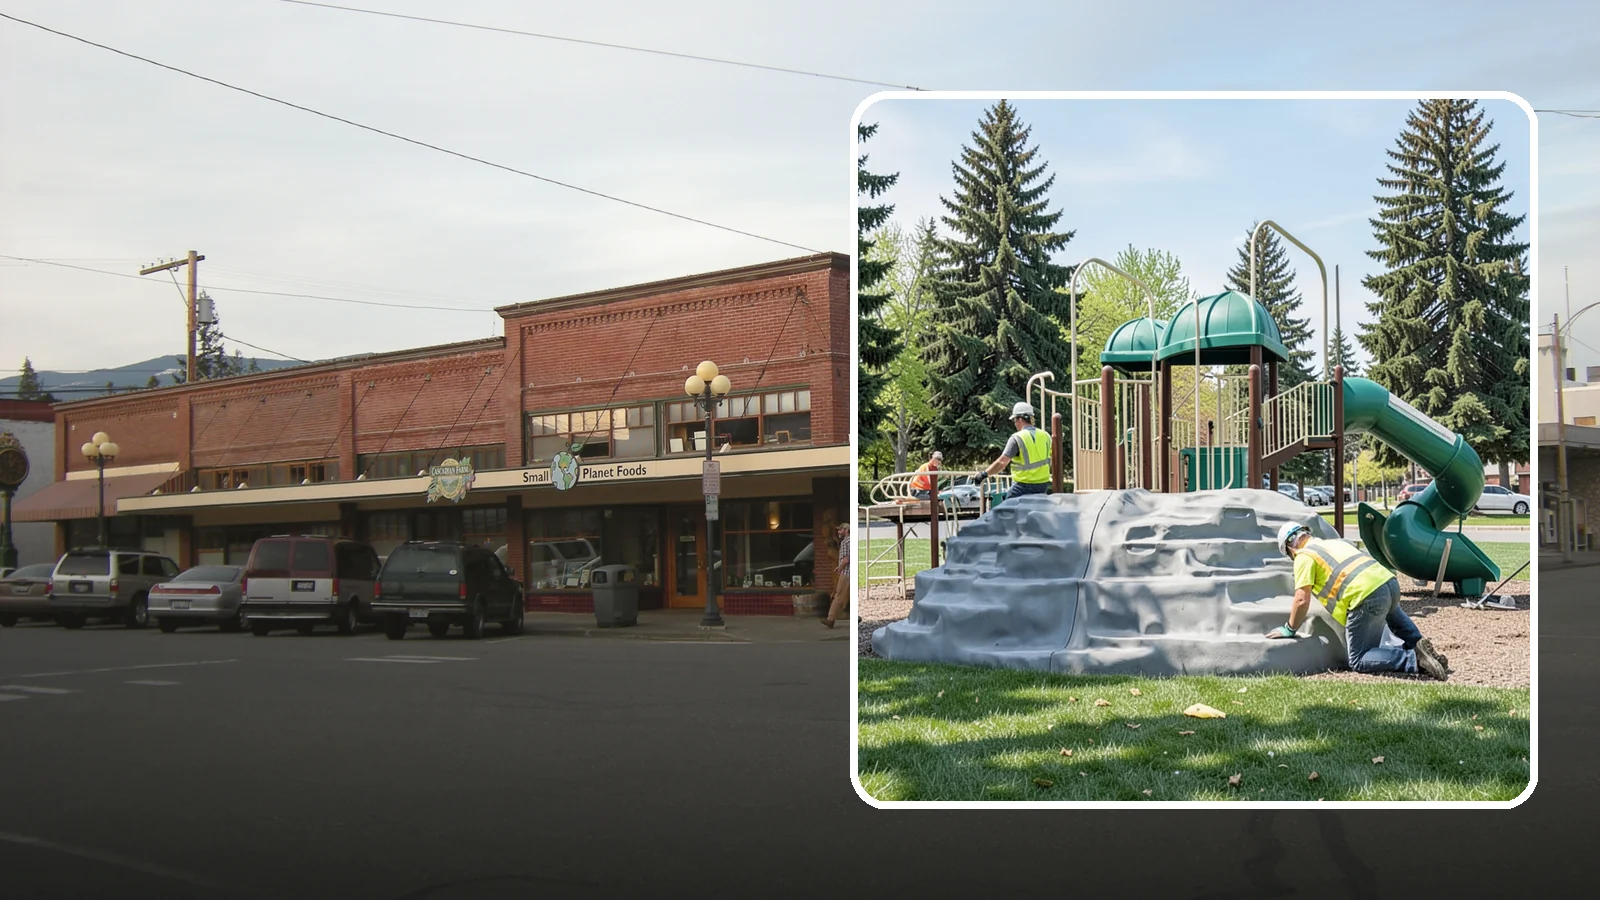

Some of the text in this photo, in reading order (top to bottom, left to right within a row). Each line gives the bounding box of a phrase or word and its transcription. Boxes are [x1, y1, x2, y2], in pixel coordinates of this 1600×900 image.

[523, 464, 647, 483] Small Planet Foods
